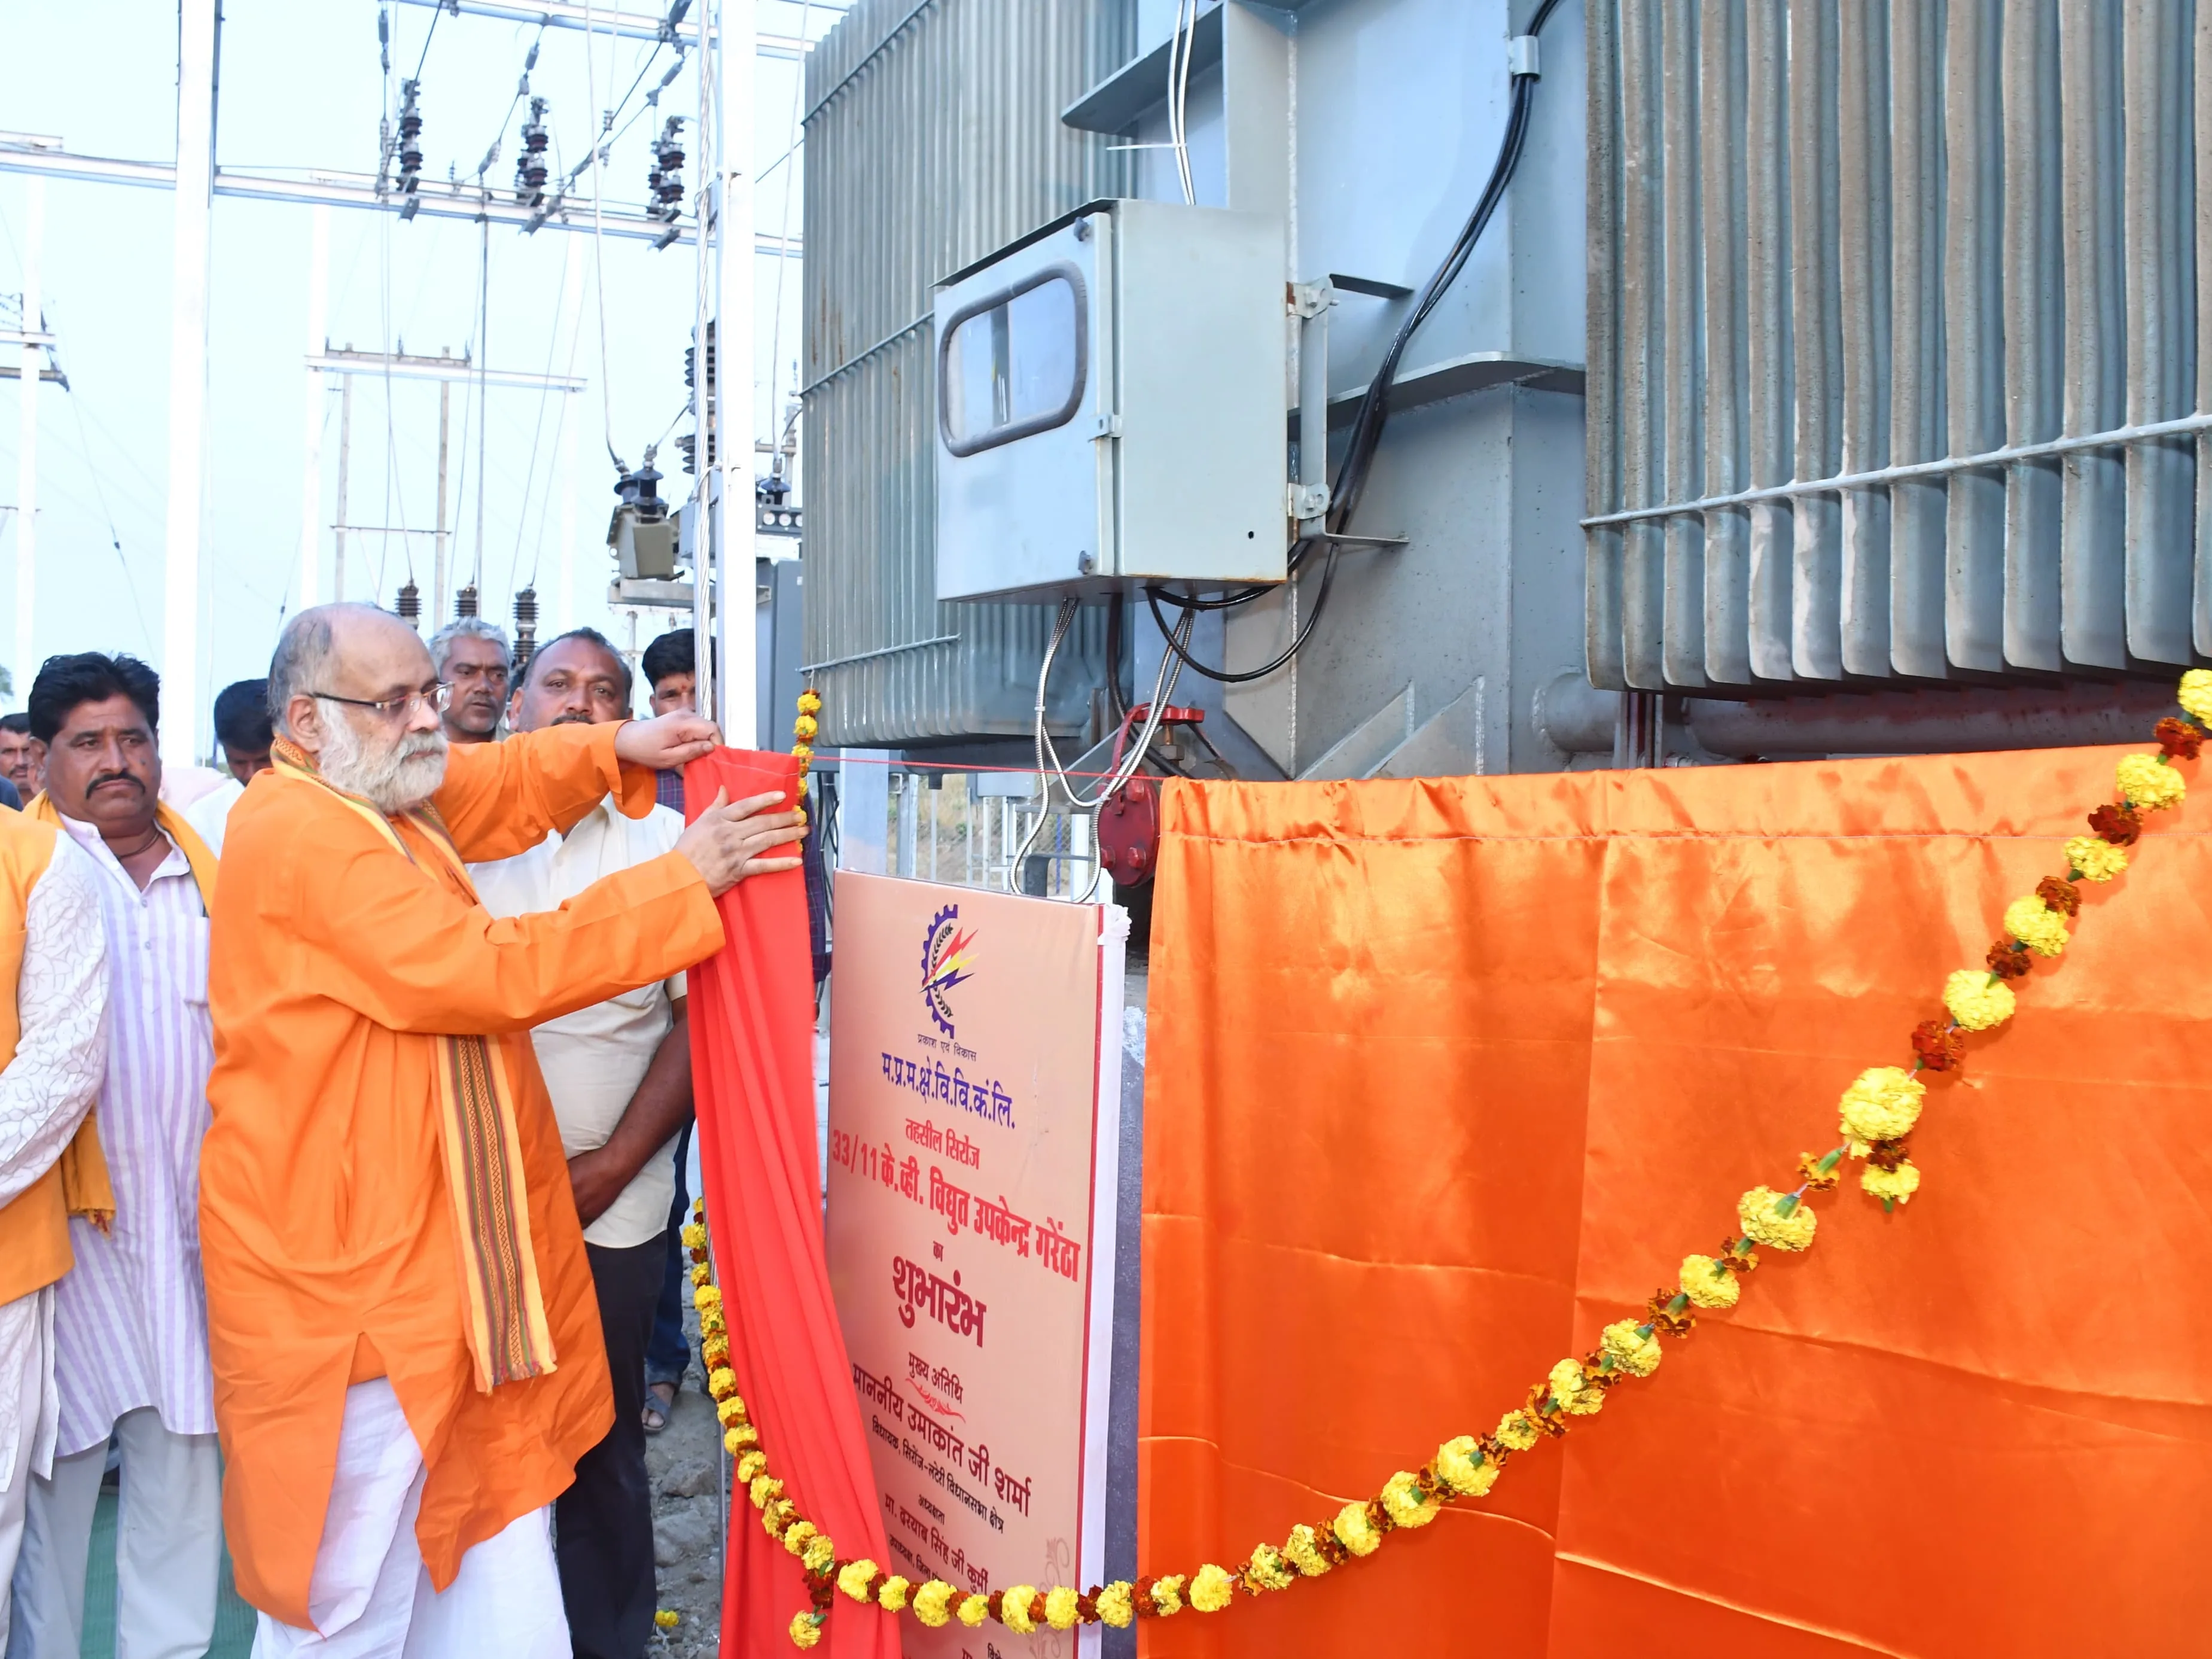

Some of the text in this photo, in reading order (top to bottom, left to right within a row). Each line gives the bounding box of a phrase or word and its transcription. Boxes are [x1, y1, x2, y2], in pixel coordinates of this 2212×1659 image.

[918, 1034, 977, 1061] प्रकाश एवं विकास
[906, 1118, 943, 1154] तहसील
[930, 1165, 970, 1235] विद्युत
[974, 1195, 1032, 1258] उपकेन्द्र
[933, 1240, 943, 1262] का
[892, 1255, 987, 1348] शुभारंभ
[909, 1351, 964, 1404] मुख्य अतिथि
[853, 1362, 1032, 1518] माननीय उमाकांत जी शर्मा
[885, 1493, 897, 1518] मा.
[931, 1526, 949, 1565] सिंह
[951, 1548, 965, 1575] जी
[946, 1472, 988, 1521] विधानसभा
[989, 1505, 1004, 1535] क्षेत्र
